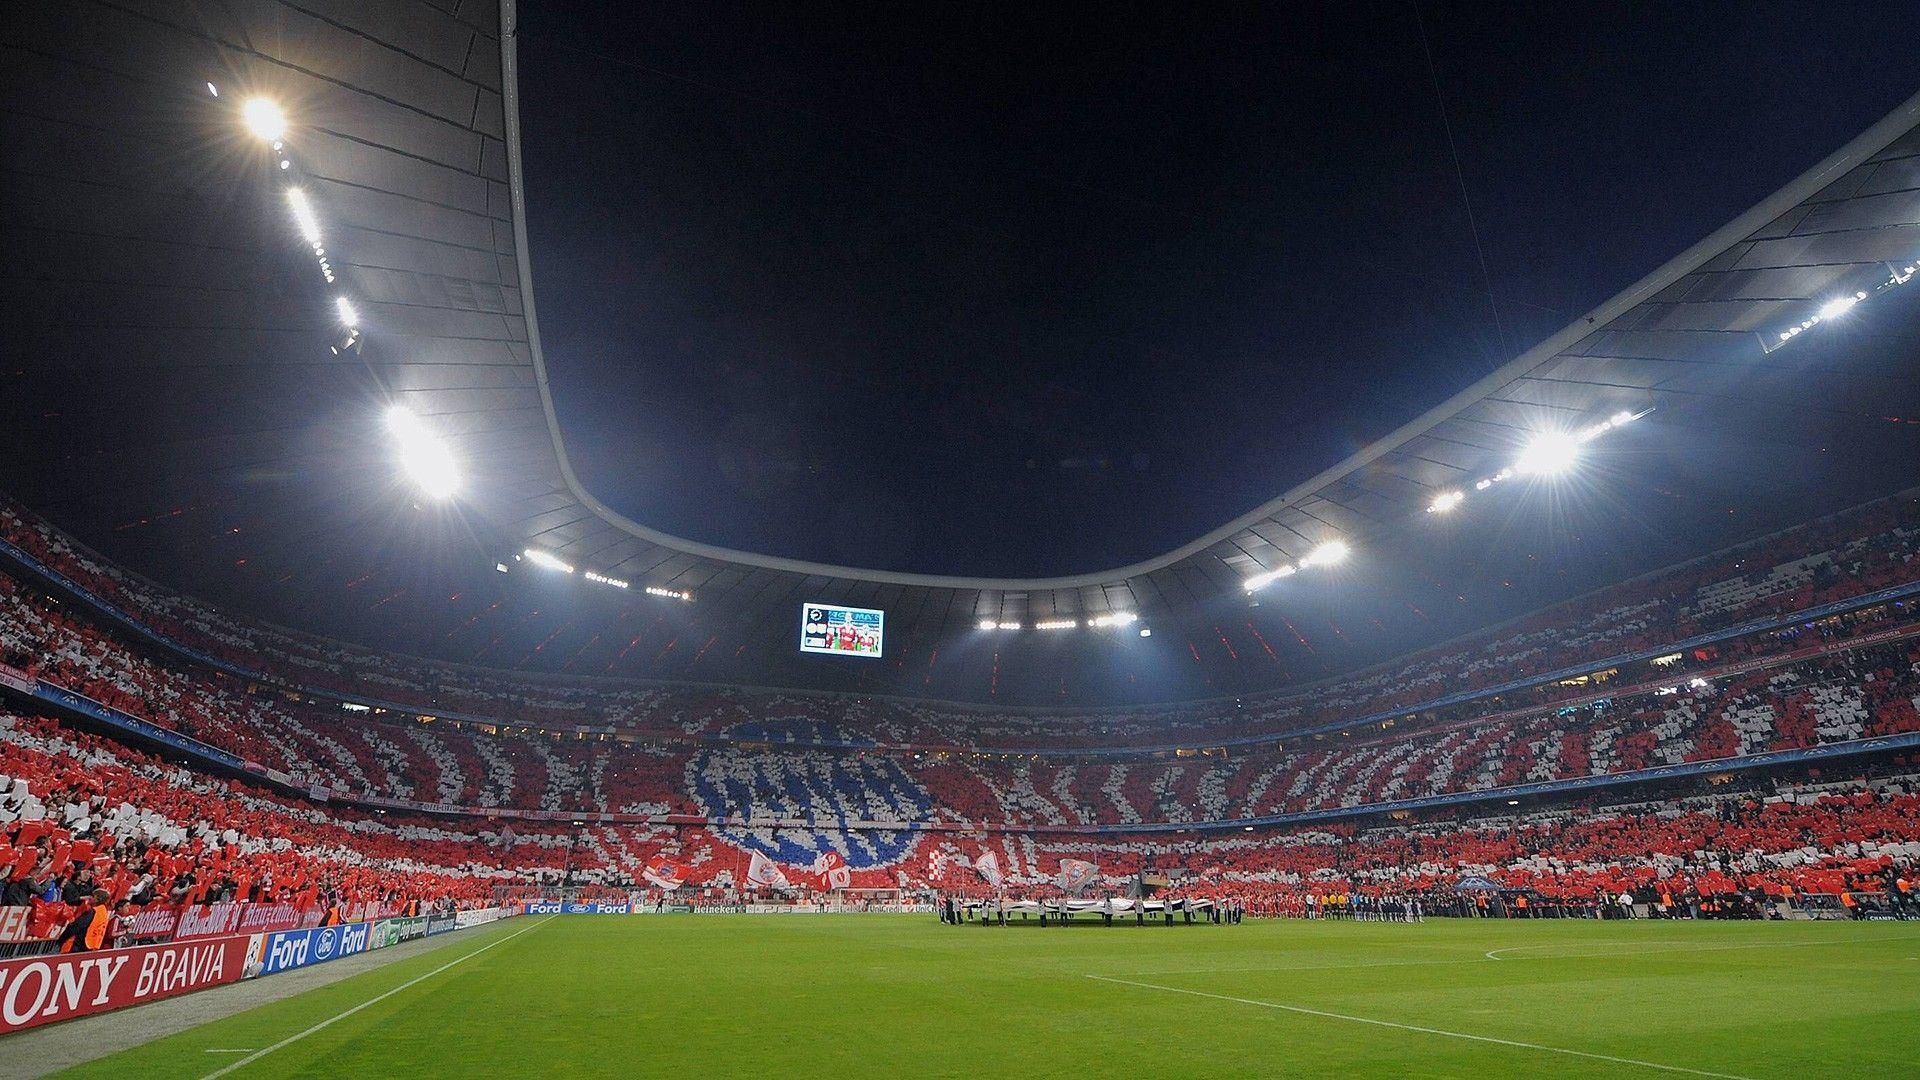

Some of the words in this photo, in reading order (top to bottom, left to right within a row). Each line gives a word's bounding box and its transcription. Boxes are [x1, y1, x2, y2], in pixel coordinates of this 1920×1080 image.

[530, 904, 562, 914] Ford
[597, 904, 627, 914] Ford
[693, 905, 736, 914] Heineken
[339, 922, 367, 956] Ford
[267, 930, 311, 972] Ford
[134, 944, 225, 998] BRAVIA
